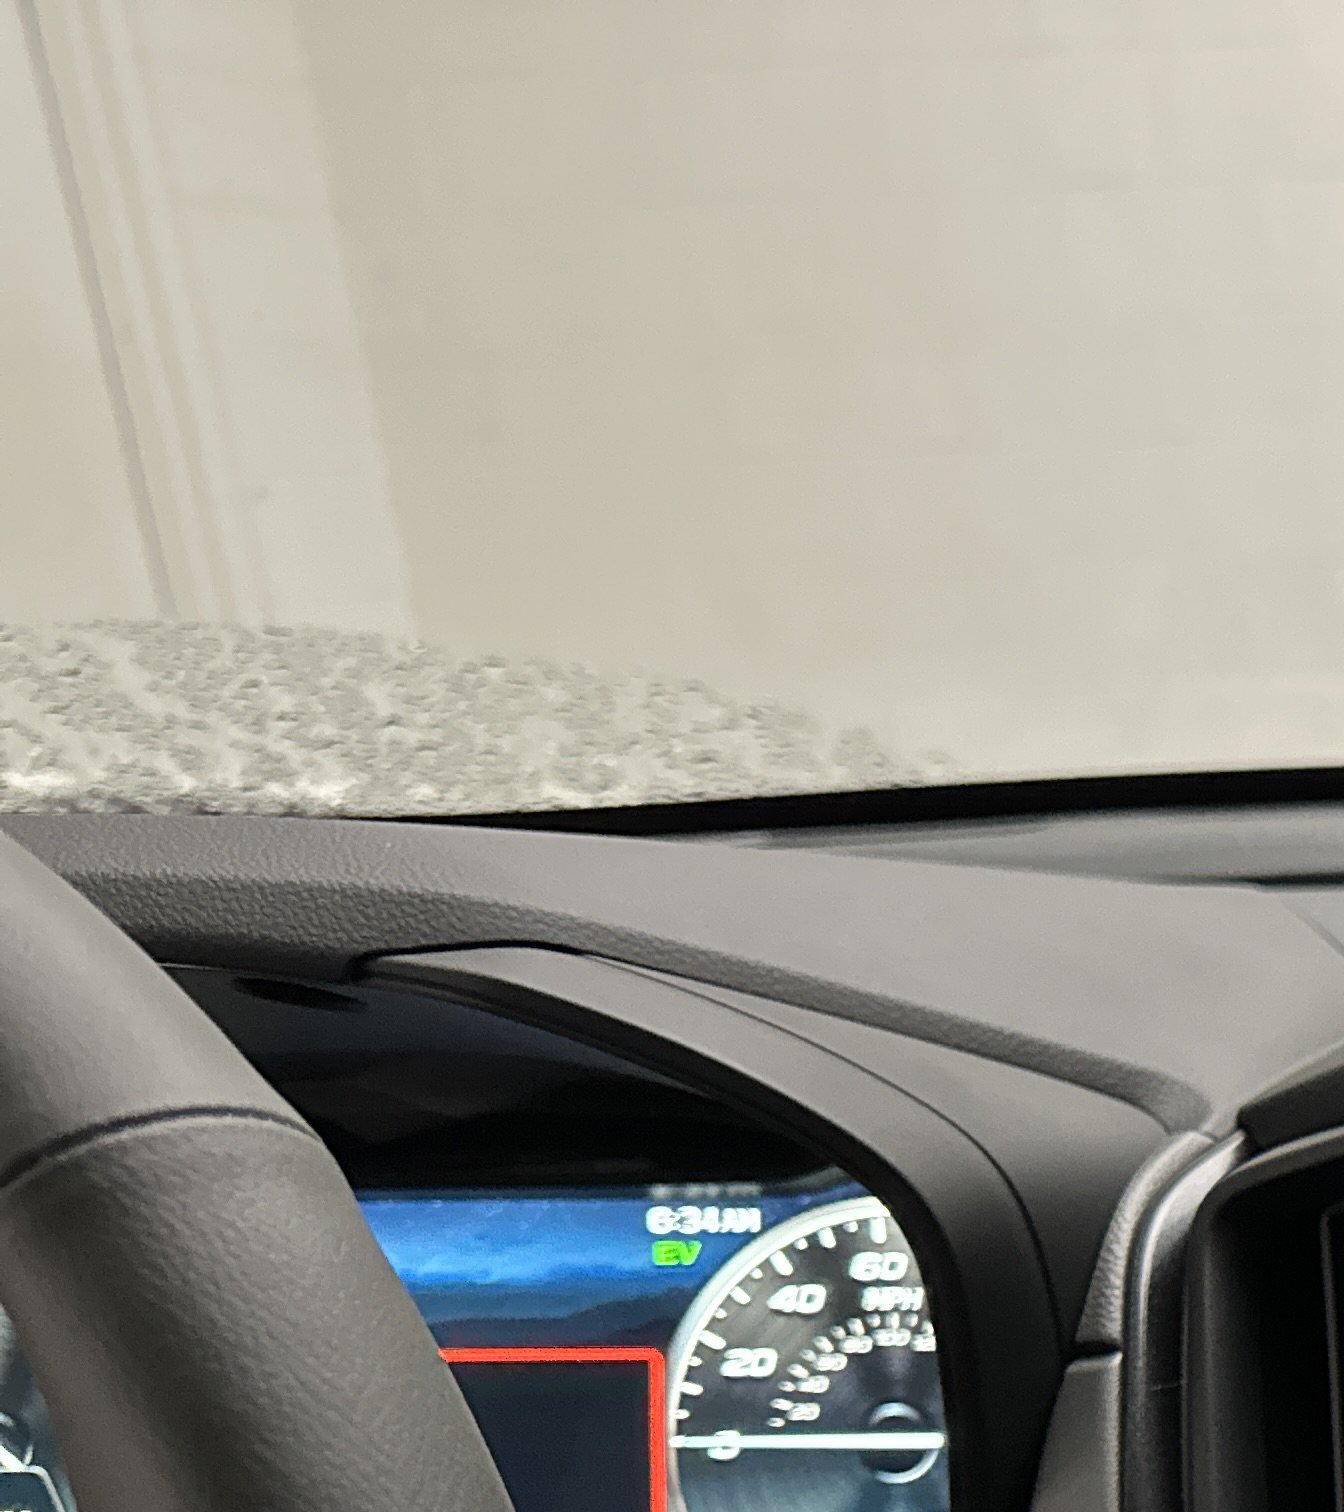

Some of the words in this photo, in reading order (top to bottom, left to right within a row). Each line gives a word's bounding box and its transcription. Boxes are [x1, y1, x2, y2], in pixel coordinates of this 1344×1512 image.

[652, 1240, 702, 1266] EV
[849, 1252, 909, 1281] 60
[767, 1284, 827, 1314] 40
[719, 1348, 778, 1377] 20
